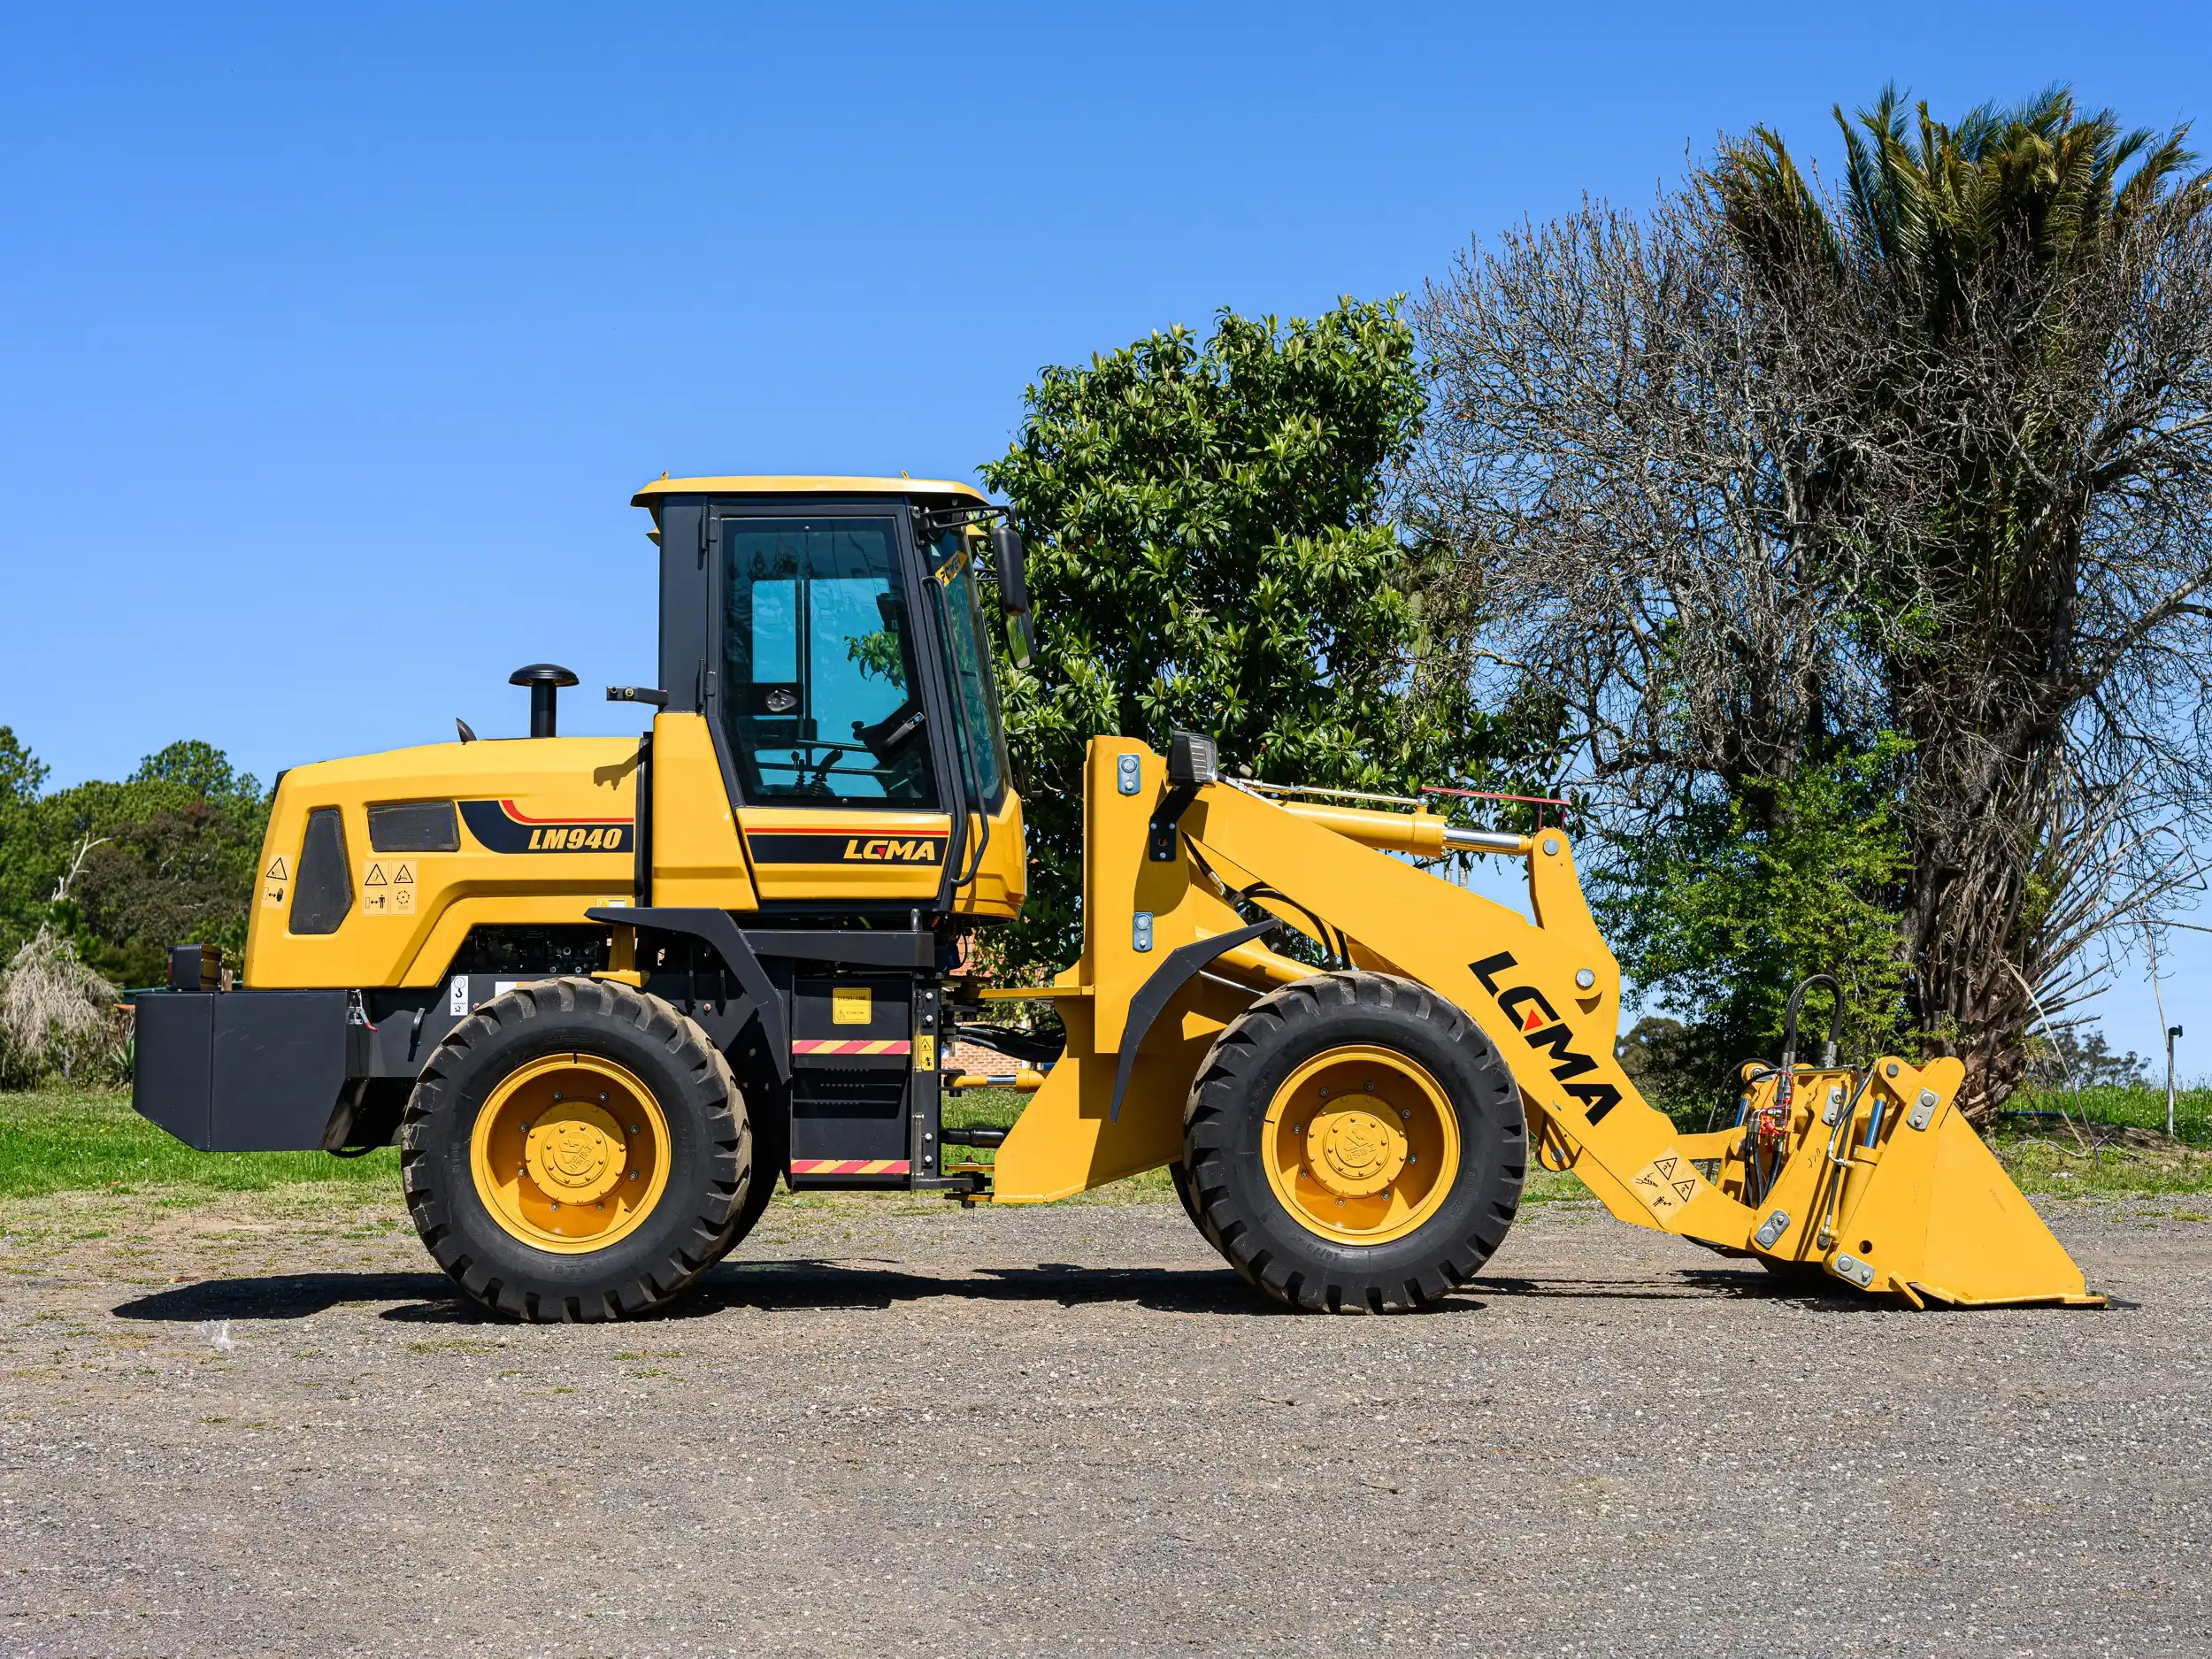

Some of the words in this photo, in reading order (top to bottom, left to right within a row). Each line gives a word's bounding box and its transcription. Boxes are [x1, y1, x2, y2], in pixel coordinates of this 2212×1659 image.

[528, 828, 623, 849] LM940
[843, 840, 935, 860] LGMA
[1468, 950, 1623, 1127] LGMA
